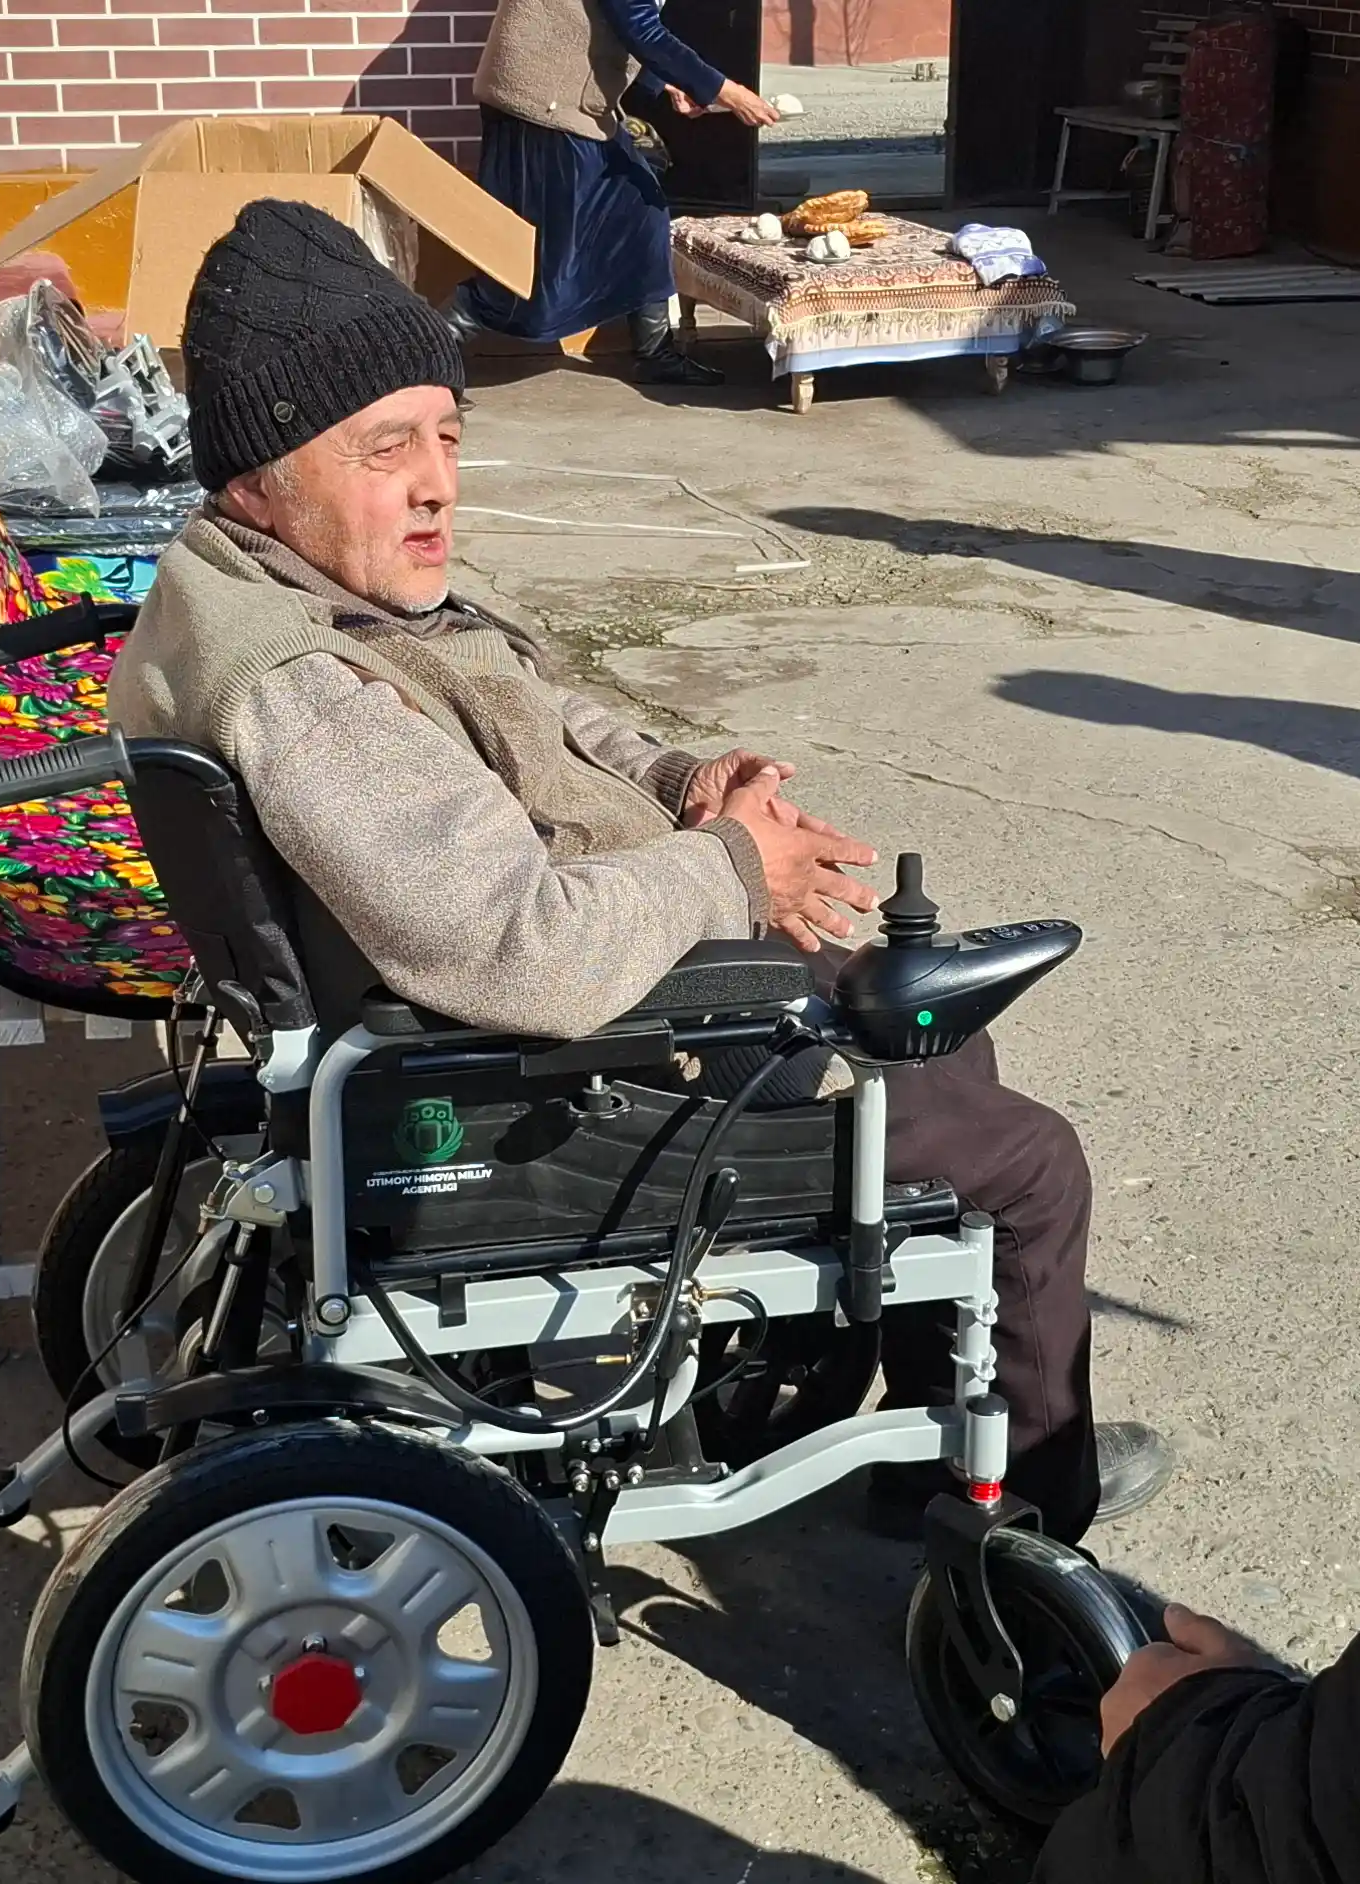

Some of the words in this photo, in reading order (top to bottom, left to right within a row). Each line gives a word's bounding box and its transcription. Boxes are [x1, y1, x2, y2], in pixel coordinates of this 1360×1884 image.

[366, 1174, 412, 1187] IJTIMOIY
[414, 1171, 456, 1184] HIMOYA
[458, 1168, 493, 1180] MILLIY
[402, 1182, 458, 1195] AGENTLIGI
